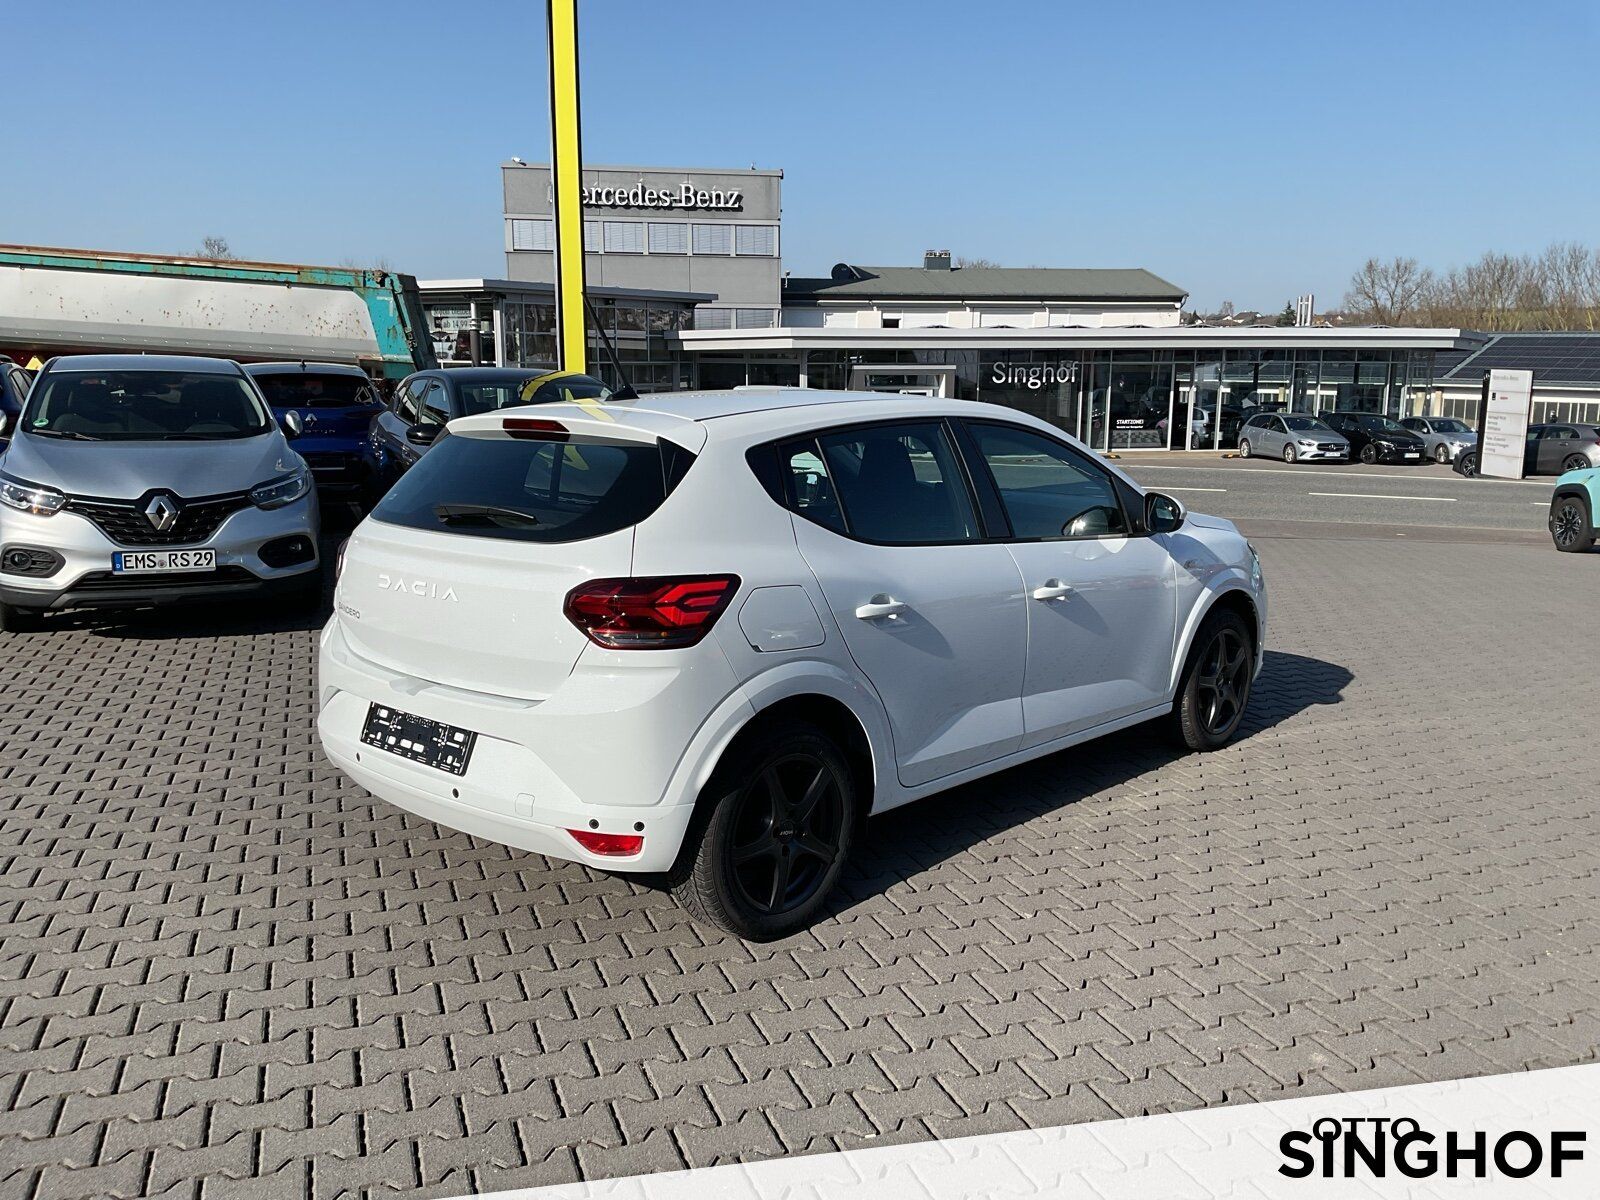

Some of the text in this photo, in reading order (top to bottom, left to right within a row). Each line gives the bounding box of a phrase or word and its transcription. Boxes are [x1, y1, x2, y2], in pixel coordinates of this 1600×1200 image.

[581, 181, 740, 208] ercedes-Benz
[992, 361, 1079, 389] Singhof
[123, 554, 157, 569] EMS
[378, 574, 459, 602] DACIA
